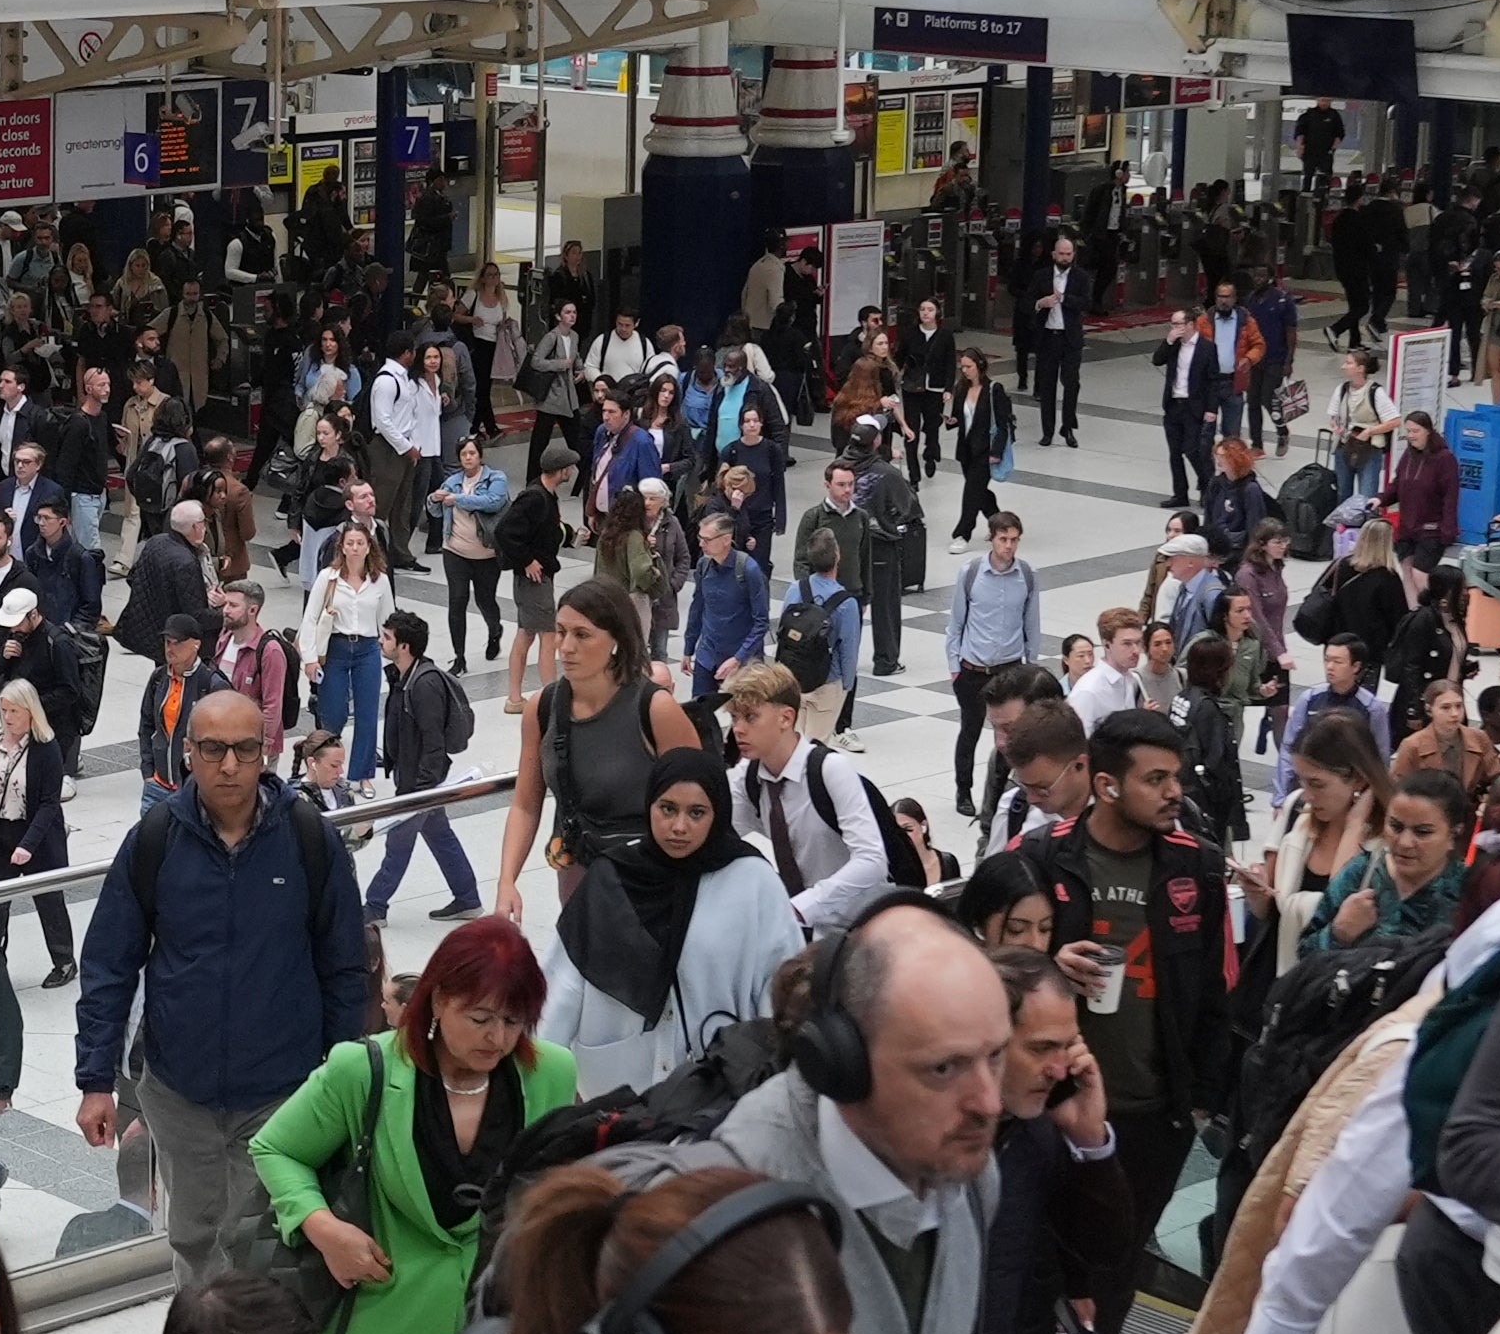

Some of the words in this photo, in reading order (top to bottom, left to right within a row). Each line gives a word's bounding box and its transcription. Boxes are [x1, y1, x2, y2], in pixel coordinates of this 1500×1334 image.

[924, 15, 977, 32] Platforms
[979, 19, 989, 33] 8
[991, 22, 1004, 34] to
[1007, 21, 1022, 35] 17
[9, 113, 41, 126] doors
[234, 97, 257, 133] 7
[2, 129, 30, 142] close
[405, 126, 420, 155] 7
[134, 142, 149, 173] 6
